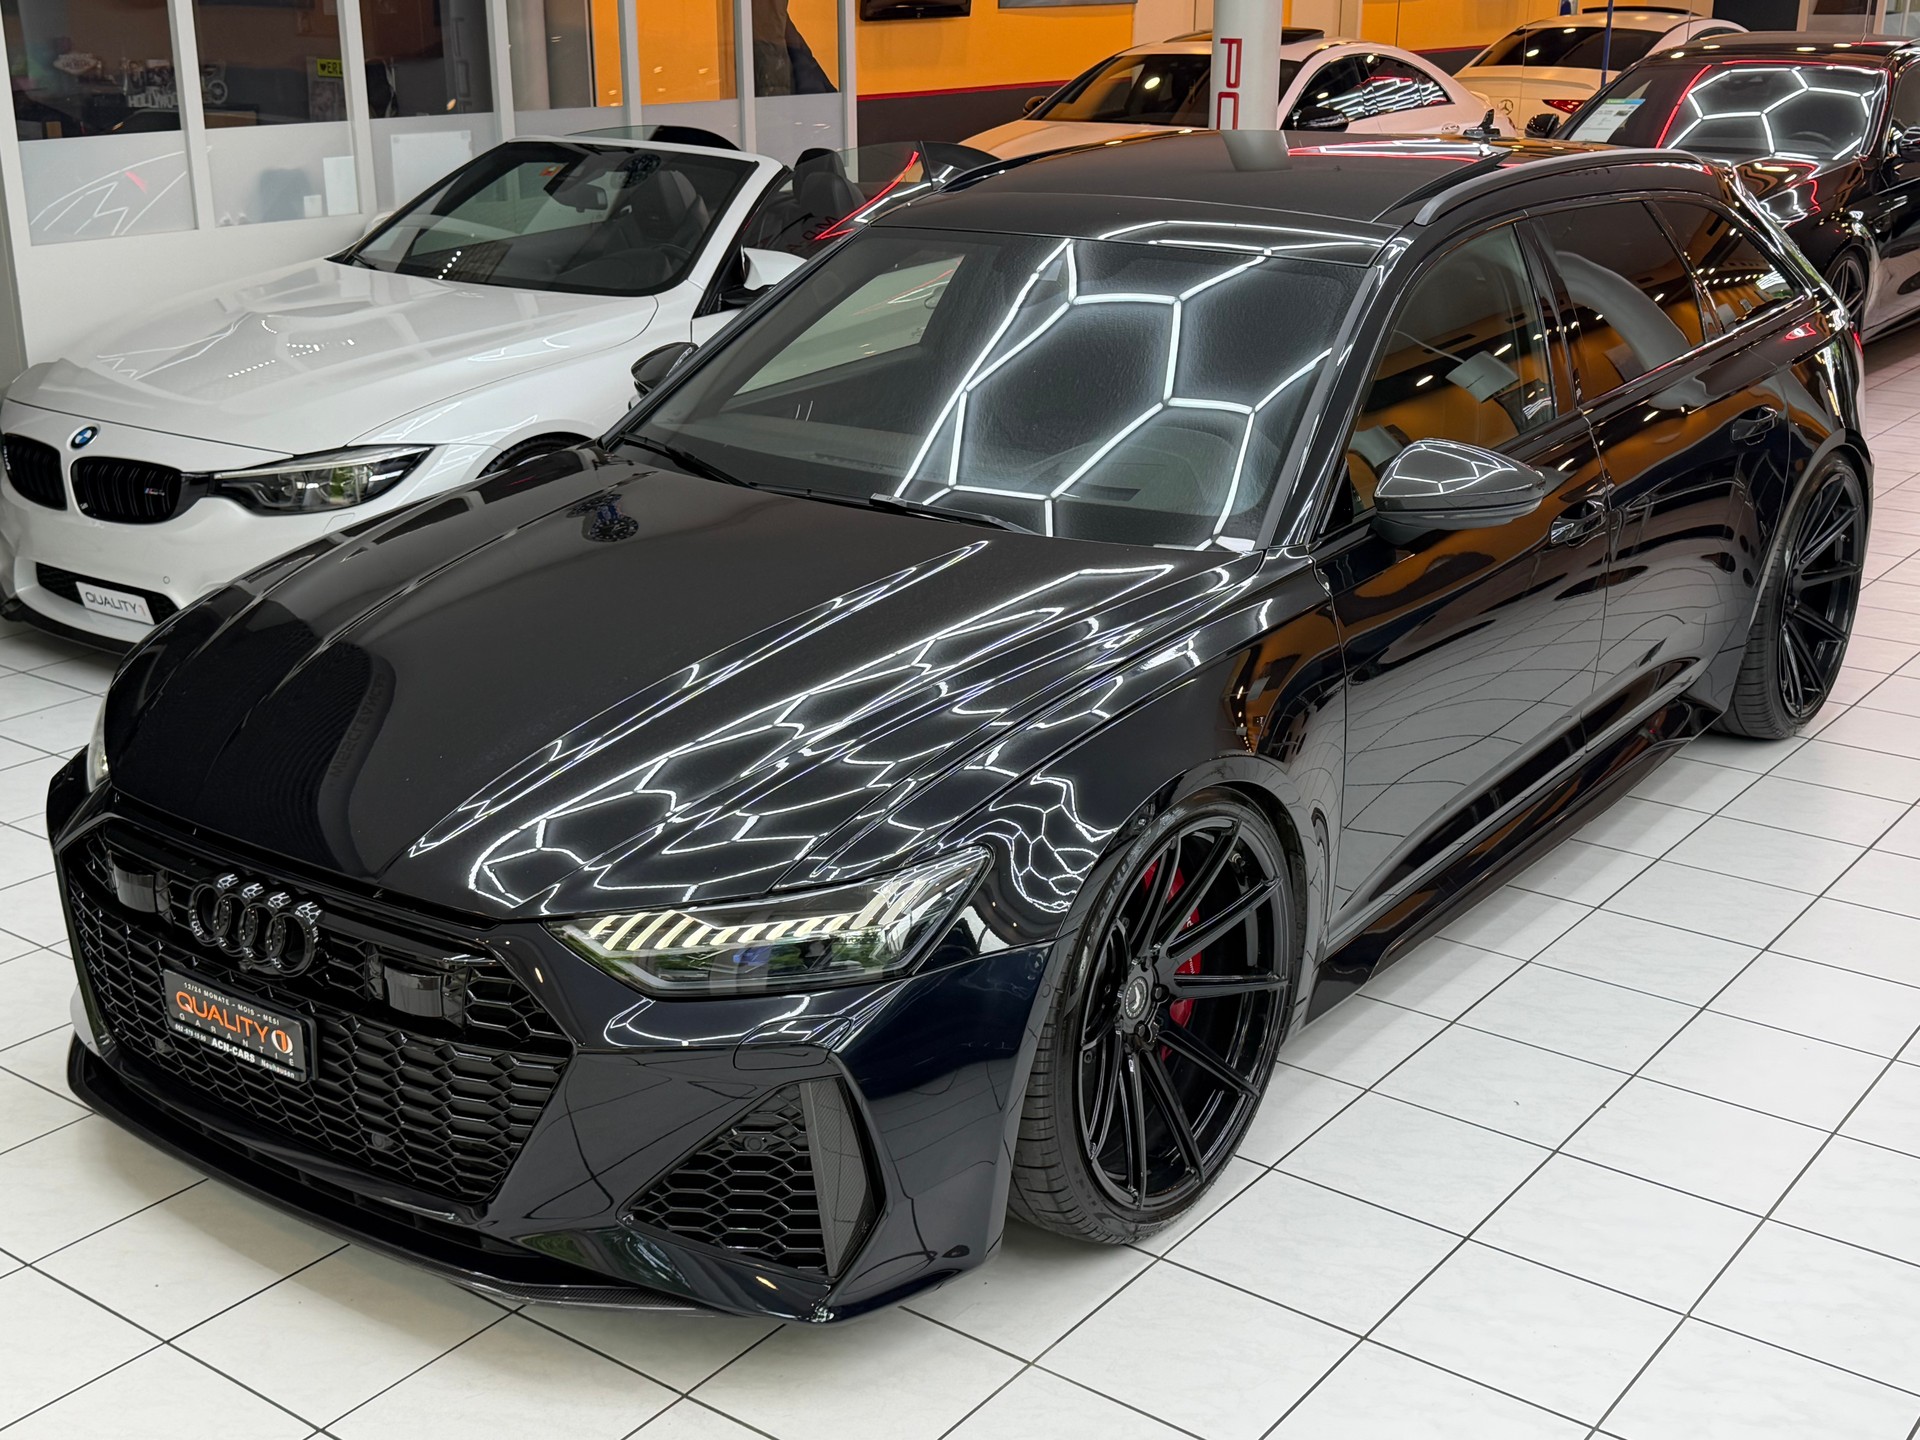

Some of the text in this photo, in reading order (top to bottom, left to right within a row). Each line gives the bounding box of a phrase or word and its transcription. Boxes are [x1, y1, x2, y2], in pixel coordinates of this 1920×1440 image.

[175, 990, 269, 1043] QUALITY
[203, 989, 230, 1006] MONATE
[237, 1003, 255, 1017] MOIS
[262, 1013, 280, 1026] MESI
[211, 1037, 256, 1064] ACN-CARS
[261, 1058, 295, 1079] Neuhausen
